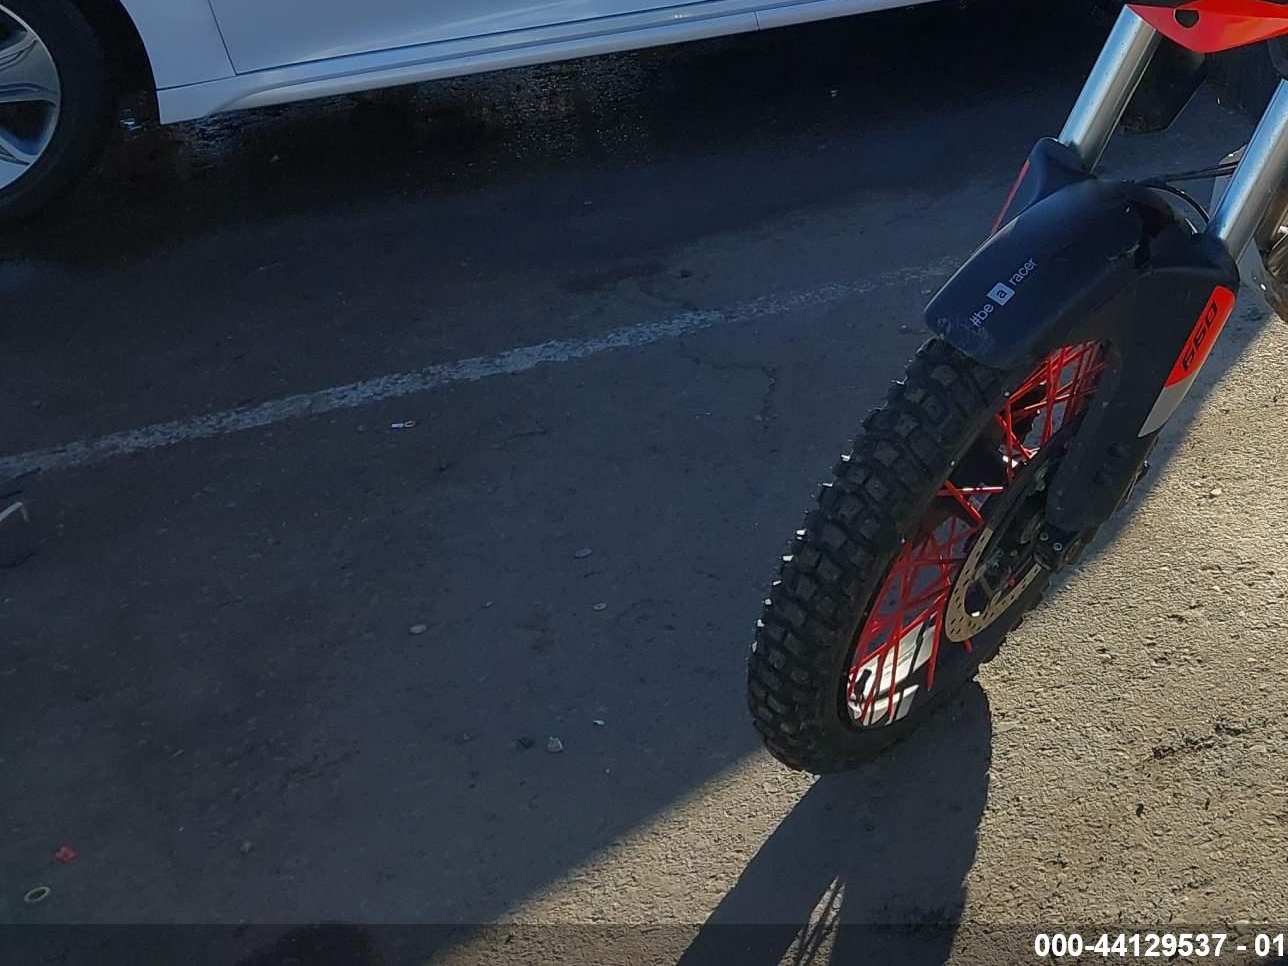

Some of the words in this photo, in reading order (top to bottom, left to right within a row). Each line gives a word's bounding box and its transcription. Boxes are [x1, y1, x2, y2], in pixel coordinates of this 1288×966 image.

[969, 304, 994, 327] #be
[1008, 258, 1037, 286] racer
[1182, 301, 1217, 370] 660
